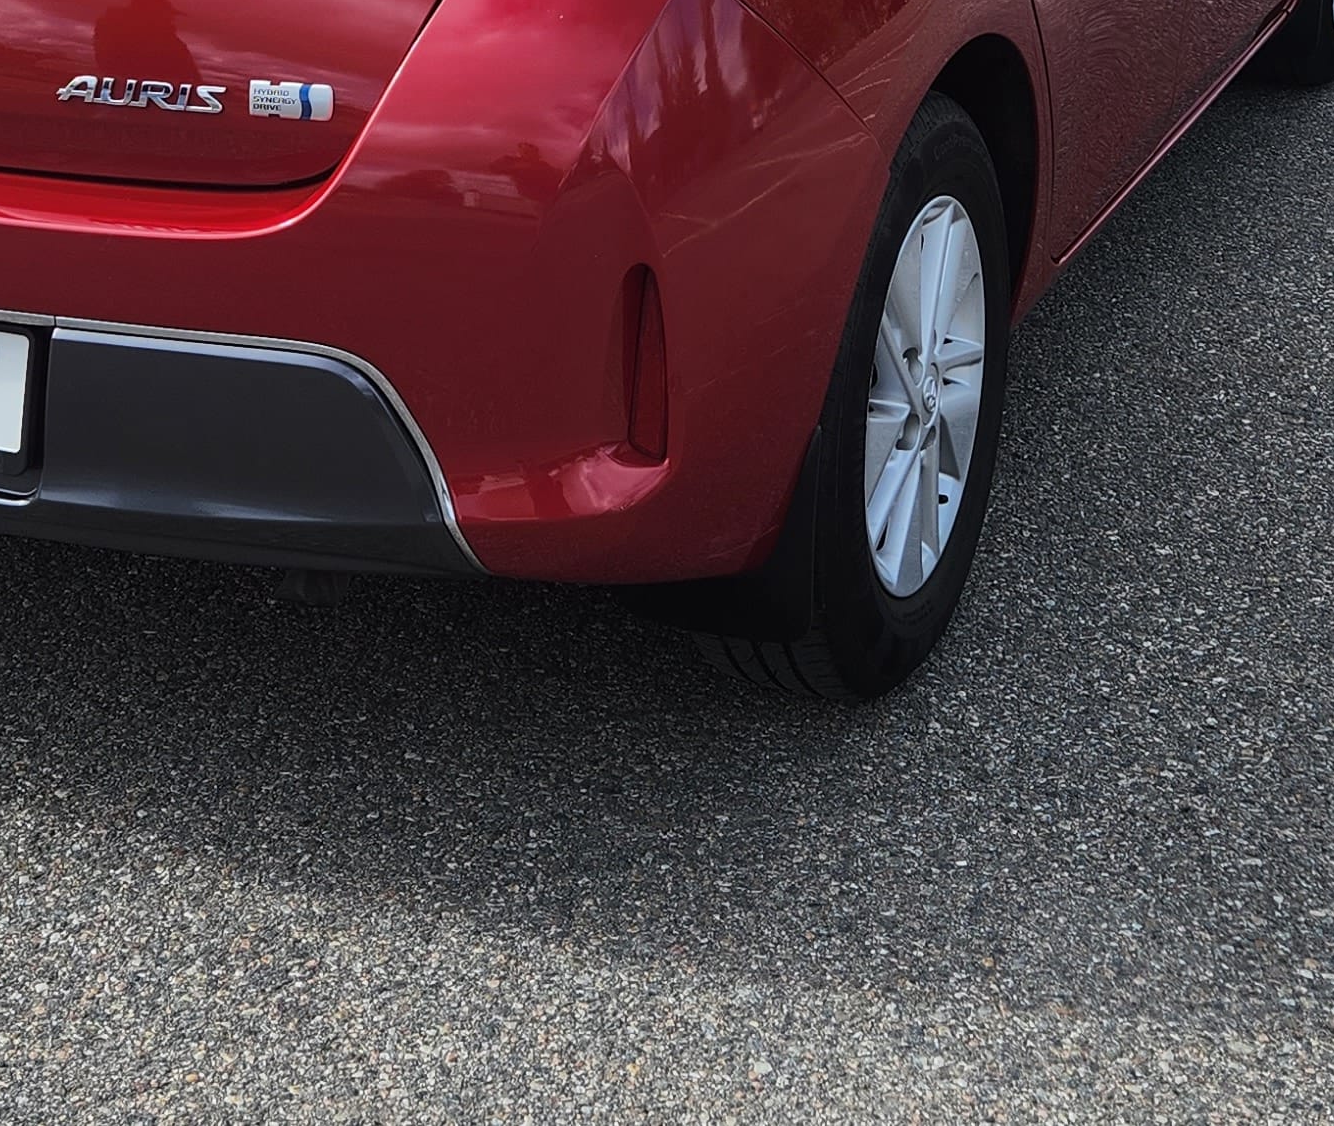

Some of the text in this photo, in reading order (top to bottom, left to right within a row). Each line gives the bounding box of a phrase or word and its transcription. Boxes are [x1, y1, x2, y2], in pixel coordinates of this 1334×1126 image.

[56, 74, 227, 114] AURIS
[253, 96, 297, 105] SYNERGY
[253, 103, 282, 111] DRIVE
